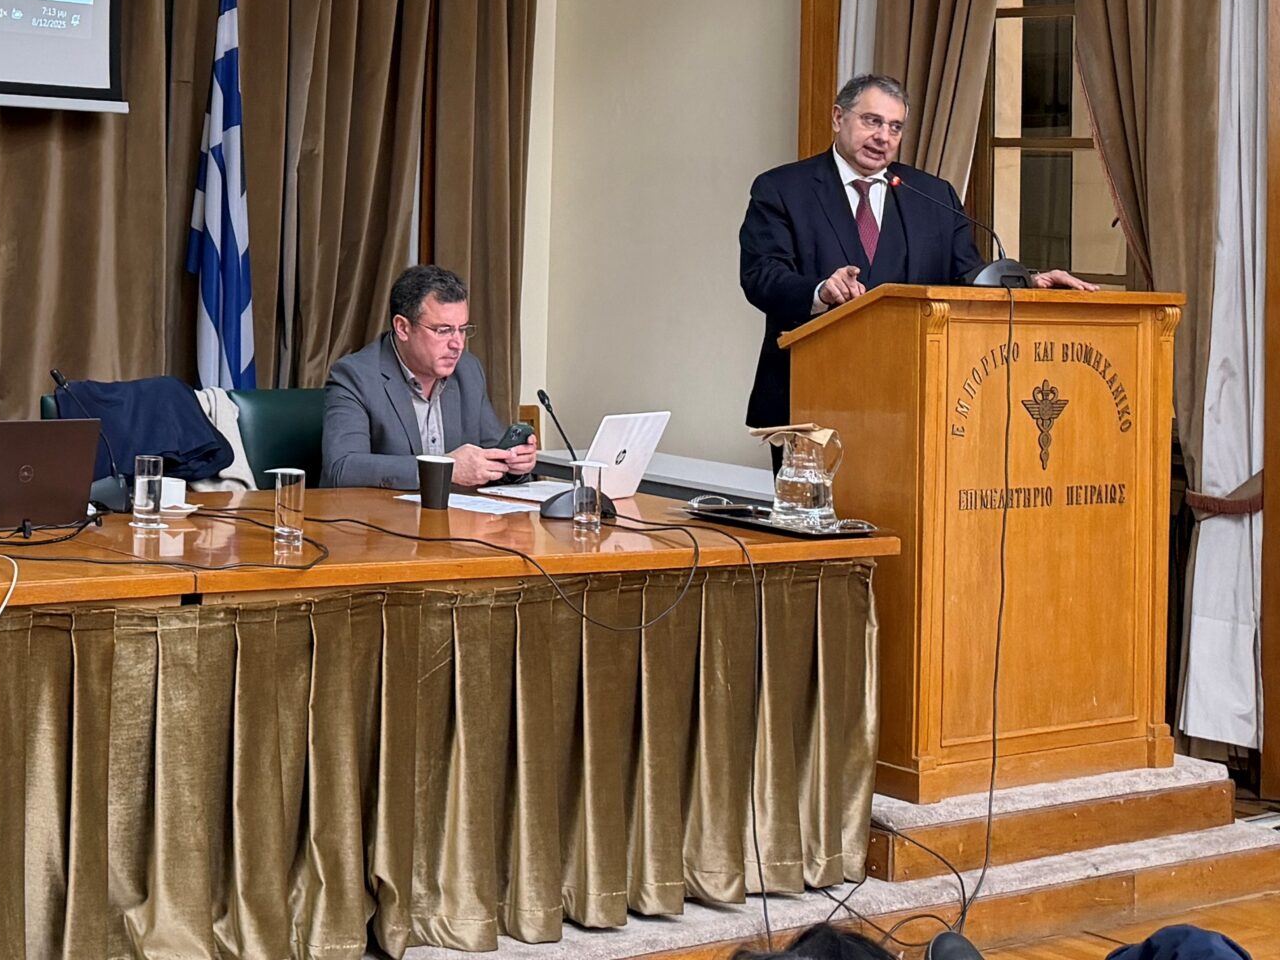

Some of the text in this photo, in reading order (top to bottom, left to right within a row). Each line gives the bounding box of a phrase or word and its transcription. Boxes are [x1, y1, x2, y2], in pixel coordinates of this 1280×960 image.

[42, 7, 57, 17] 7:13
[32, 18, 67, 29] 8/12/2025
[952, 342, 1132, 438] ΕΜΠΟΡΙΚΟ ΚΑΙ ΒΙΟΜΗΧΑΝΙΚΟ
[958, 483, 1126, 510] ΕΠΙΜΕΛΗΤΗΡΙΟ ΠΕΙΡΑΙΩΣ
